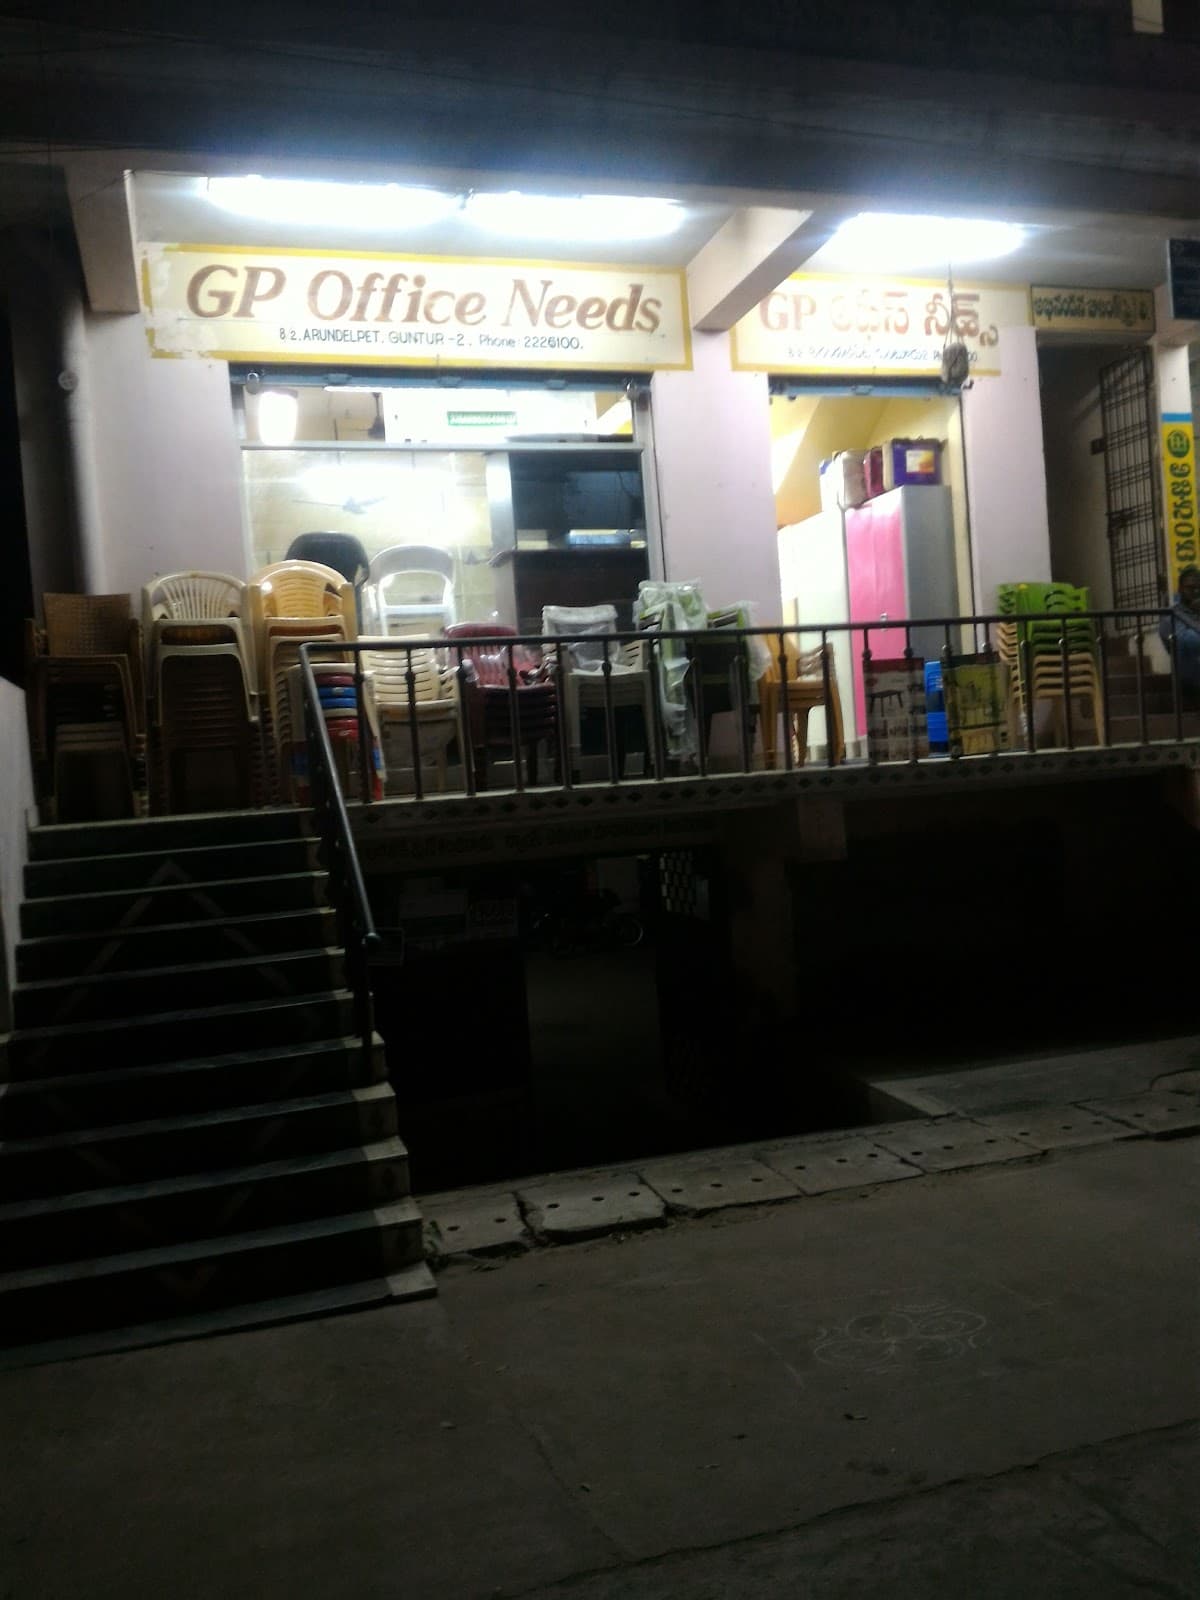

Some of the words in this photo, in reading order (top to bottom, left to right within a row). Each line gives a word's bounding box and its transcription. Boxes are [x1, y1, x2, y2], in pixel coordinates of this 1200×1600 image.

[186, 264, 287, 320] GP
[307, 269, 488, 326] Office
[502, 278, 662, 335] Needs
[759, 291, 818, 332] GP
